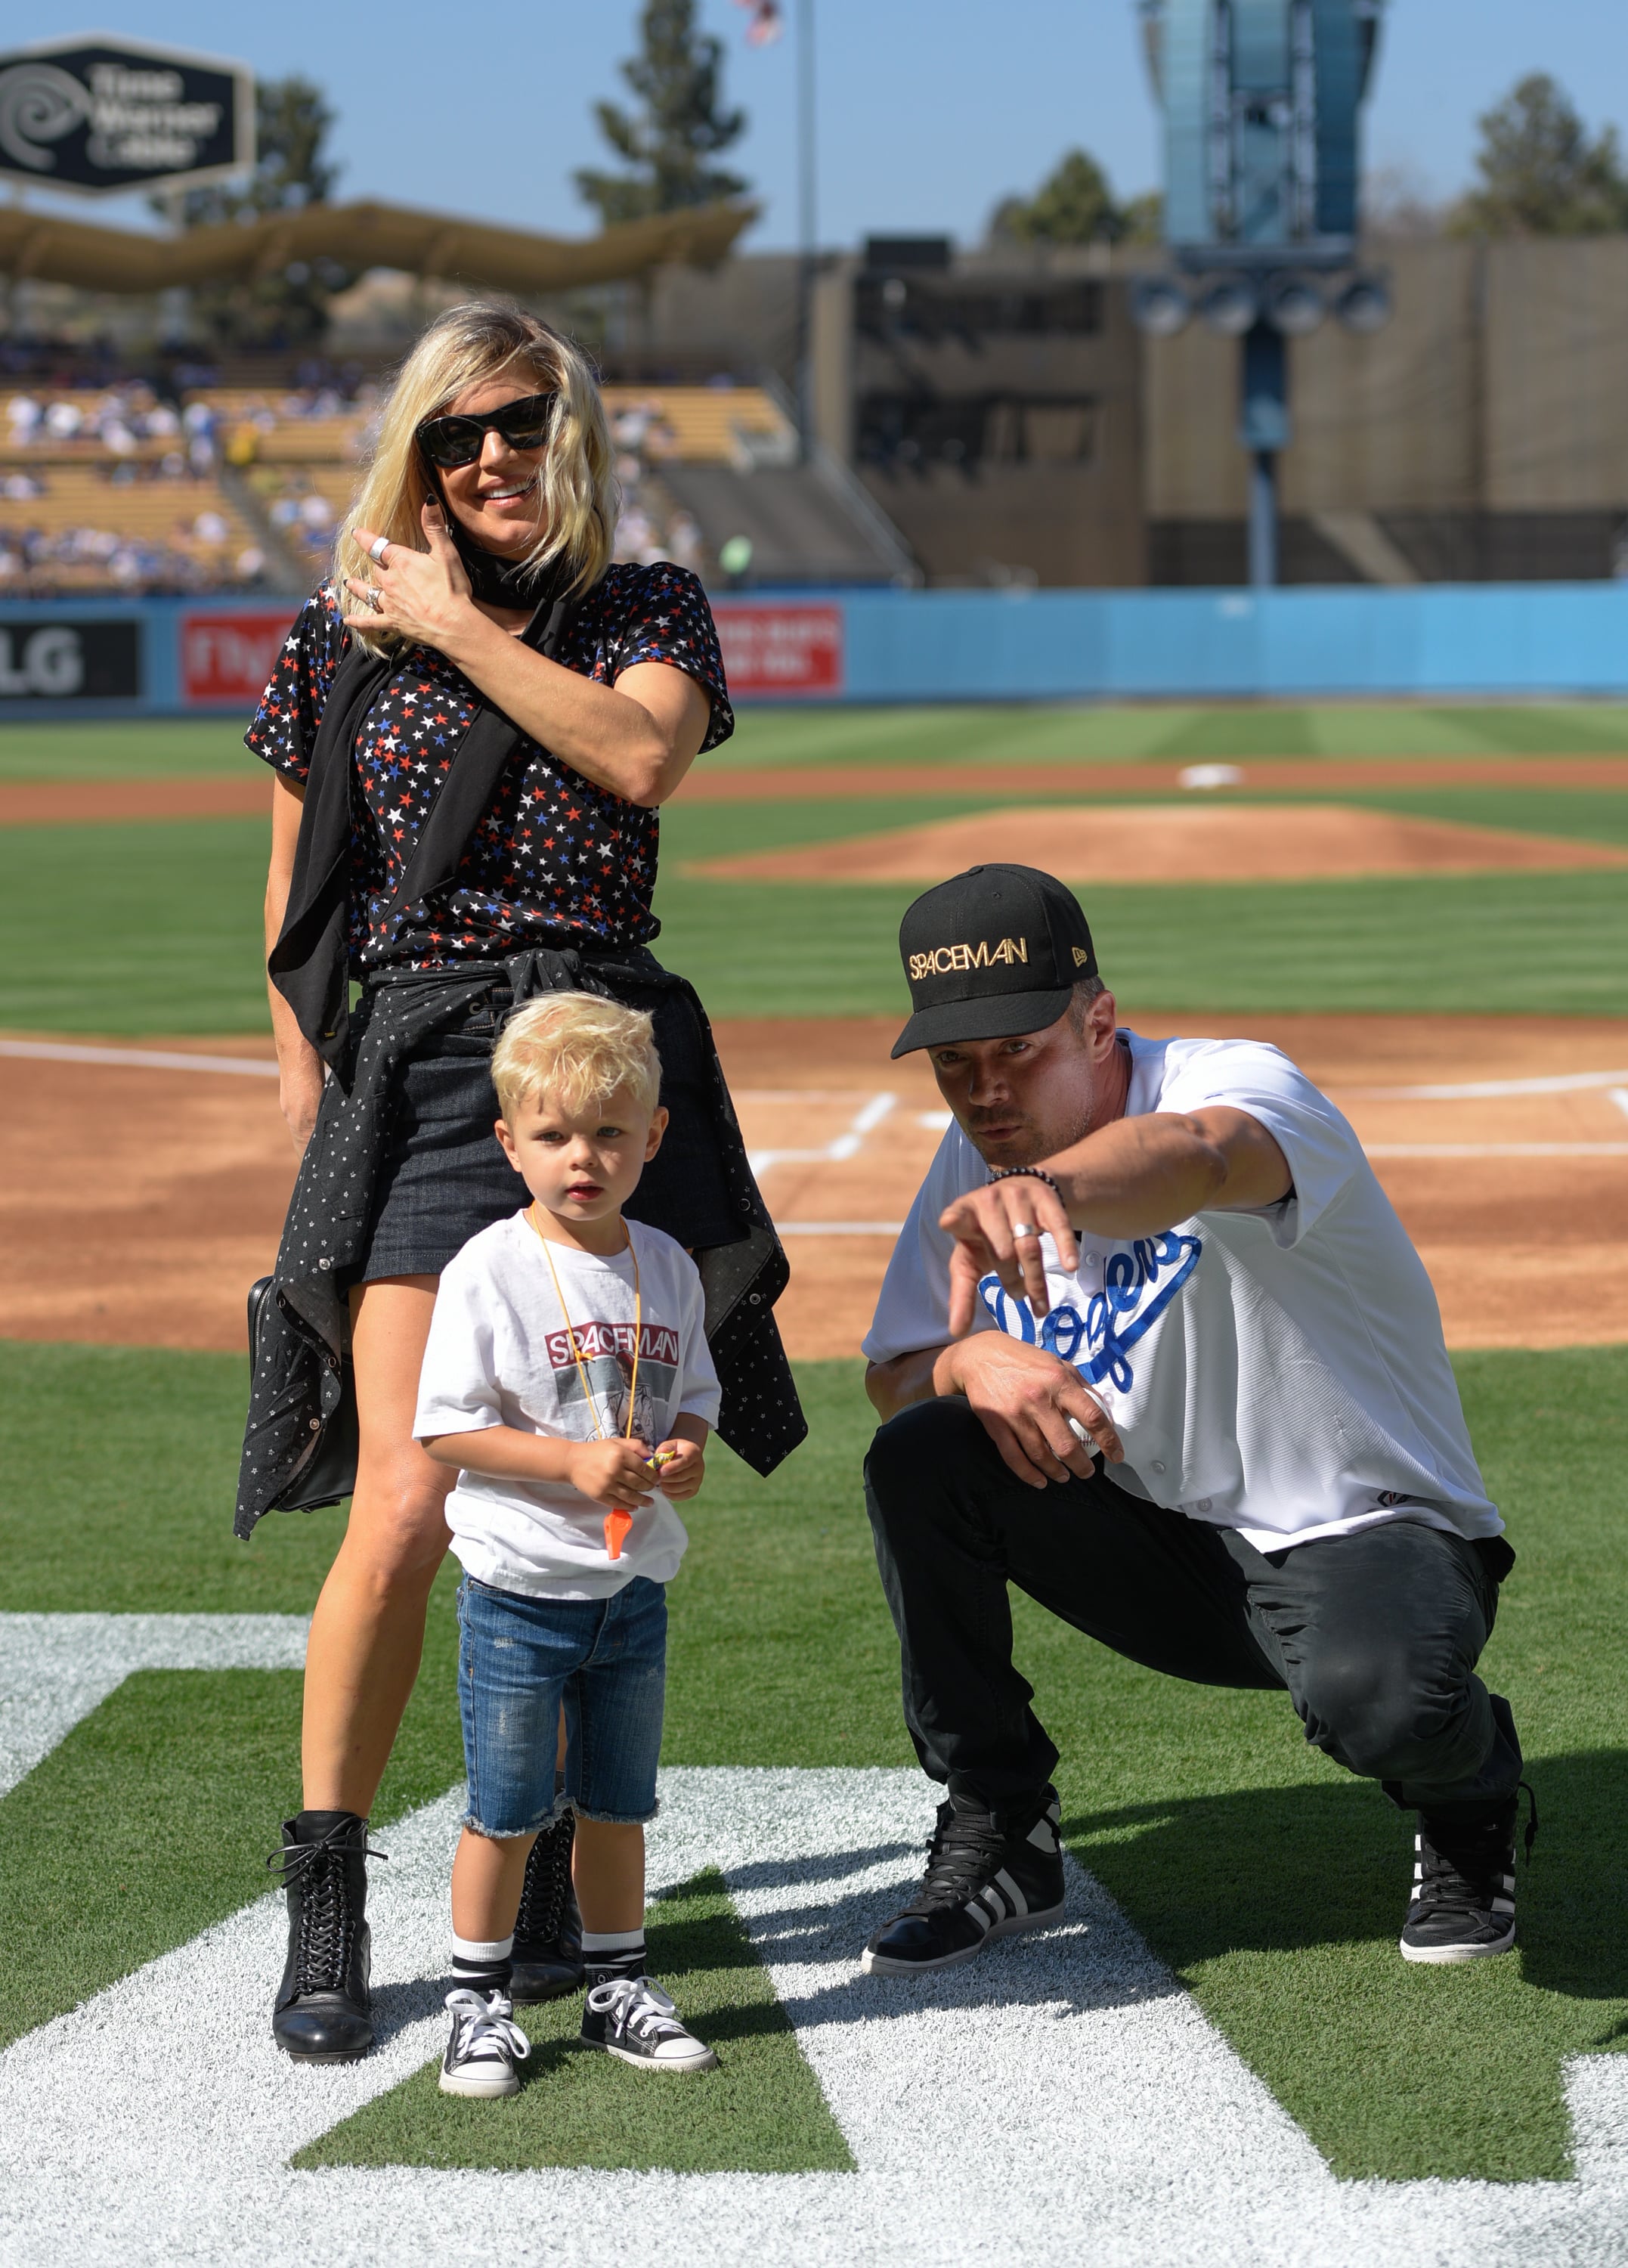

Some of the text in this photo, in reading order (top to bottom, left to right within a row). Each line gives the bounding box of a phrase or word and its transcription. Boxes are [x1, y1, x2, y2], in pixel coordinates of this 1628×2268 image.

[87, 64, 184, 100] Time
[90, 101, 222, 138] Warner
[85, 135, 197, 169] Cable
[0, 627, 85, 694] LG
[908, 937, 1028, 982] SPACEMAN
[549, 1325, 677, 1364] SPACEMAN
